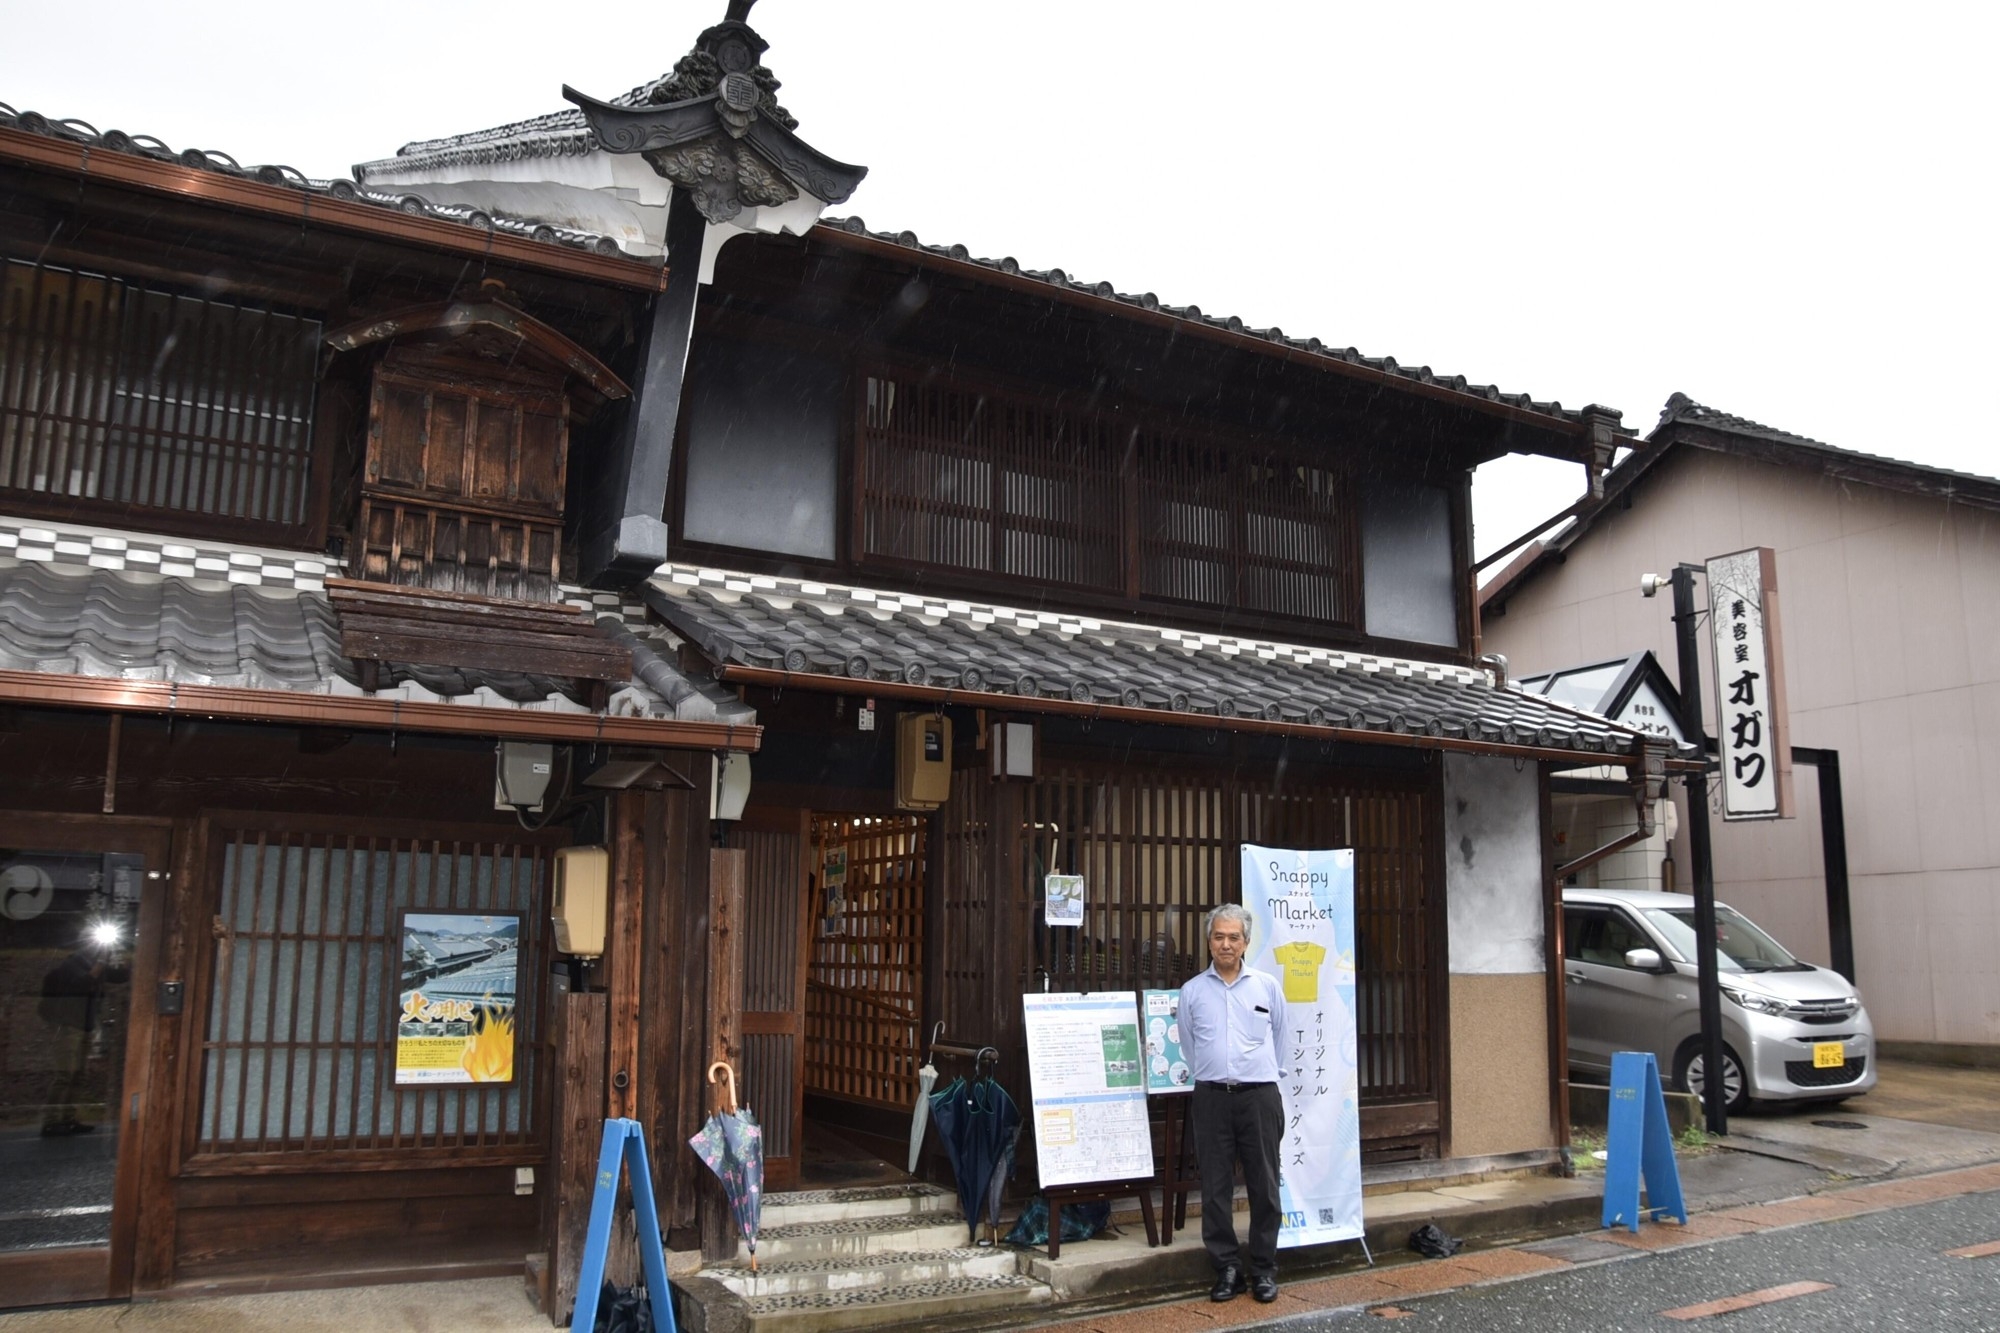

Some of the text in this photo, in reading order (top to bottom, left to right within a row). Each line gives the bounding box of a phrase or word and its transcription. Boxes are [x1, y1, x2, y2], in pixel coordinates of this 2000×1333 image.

[1731, 599, 1750, 664] 美容室
[1728, 669, 1766, 788] オガワ
[1269, 861, 1329, 889] Snappy
[1267, 898, 1333, 921] Market
[1290, 969, 1314, 977] Market
[1291, 956, 1313, 966] Snappy
[400, 991, 475, 1023] 火の用心
[1313, 1010, 1329, 1097] オリジナル
[1281, 1211, 1305, 1229] NAP
